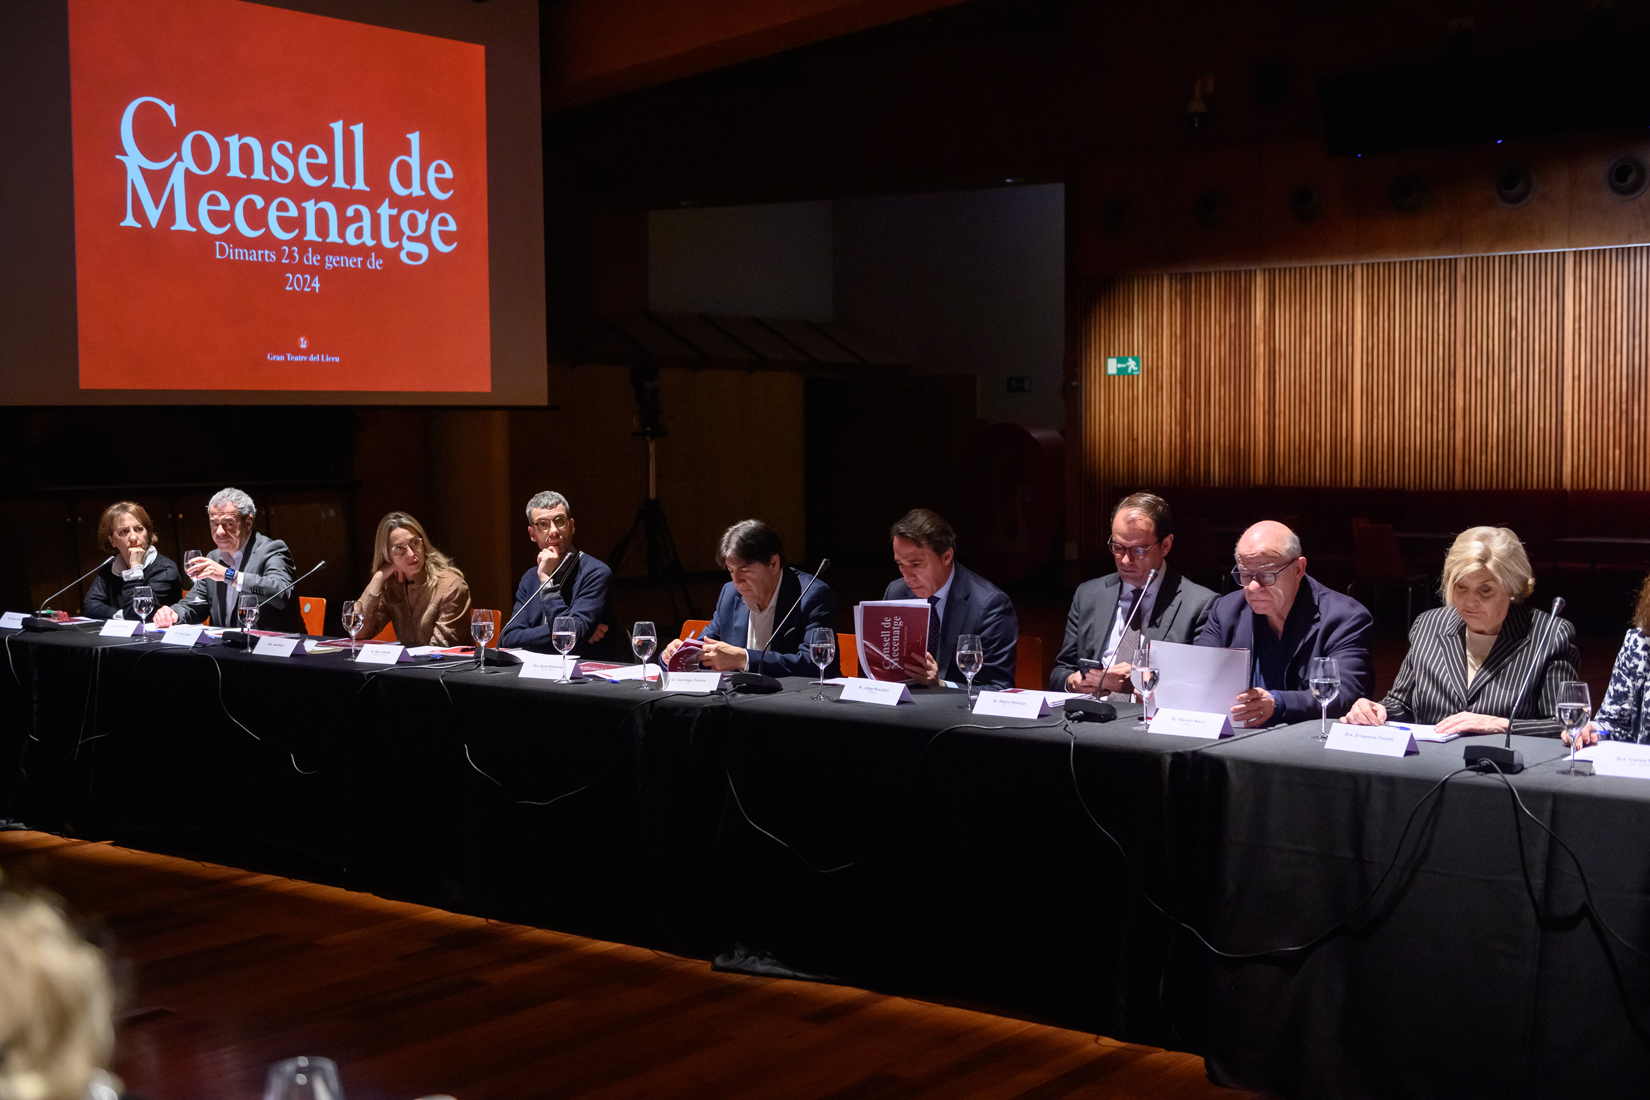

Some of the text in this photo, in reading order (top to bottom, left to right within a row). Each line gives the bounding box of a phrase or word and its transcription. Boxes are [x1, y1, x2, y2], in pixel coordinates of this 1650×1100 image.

[120, 96, 455, 200] Consell de
[115, 153, 458, 265] Mecenatge
[215, 241, 384, 270] Dimarts 23 de gener de
[285, 273, 321, 293] 2024
[267, 353, 340, 362] Gran Teatre del Liceu
[881, 617, 892, 628] de
